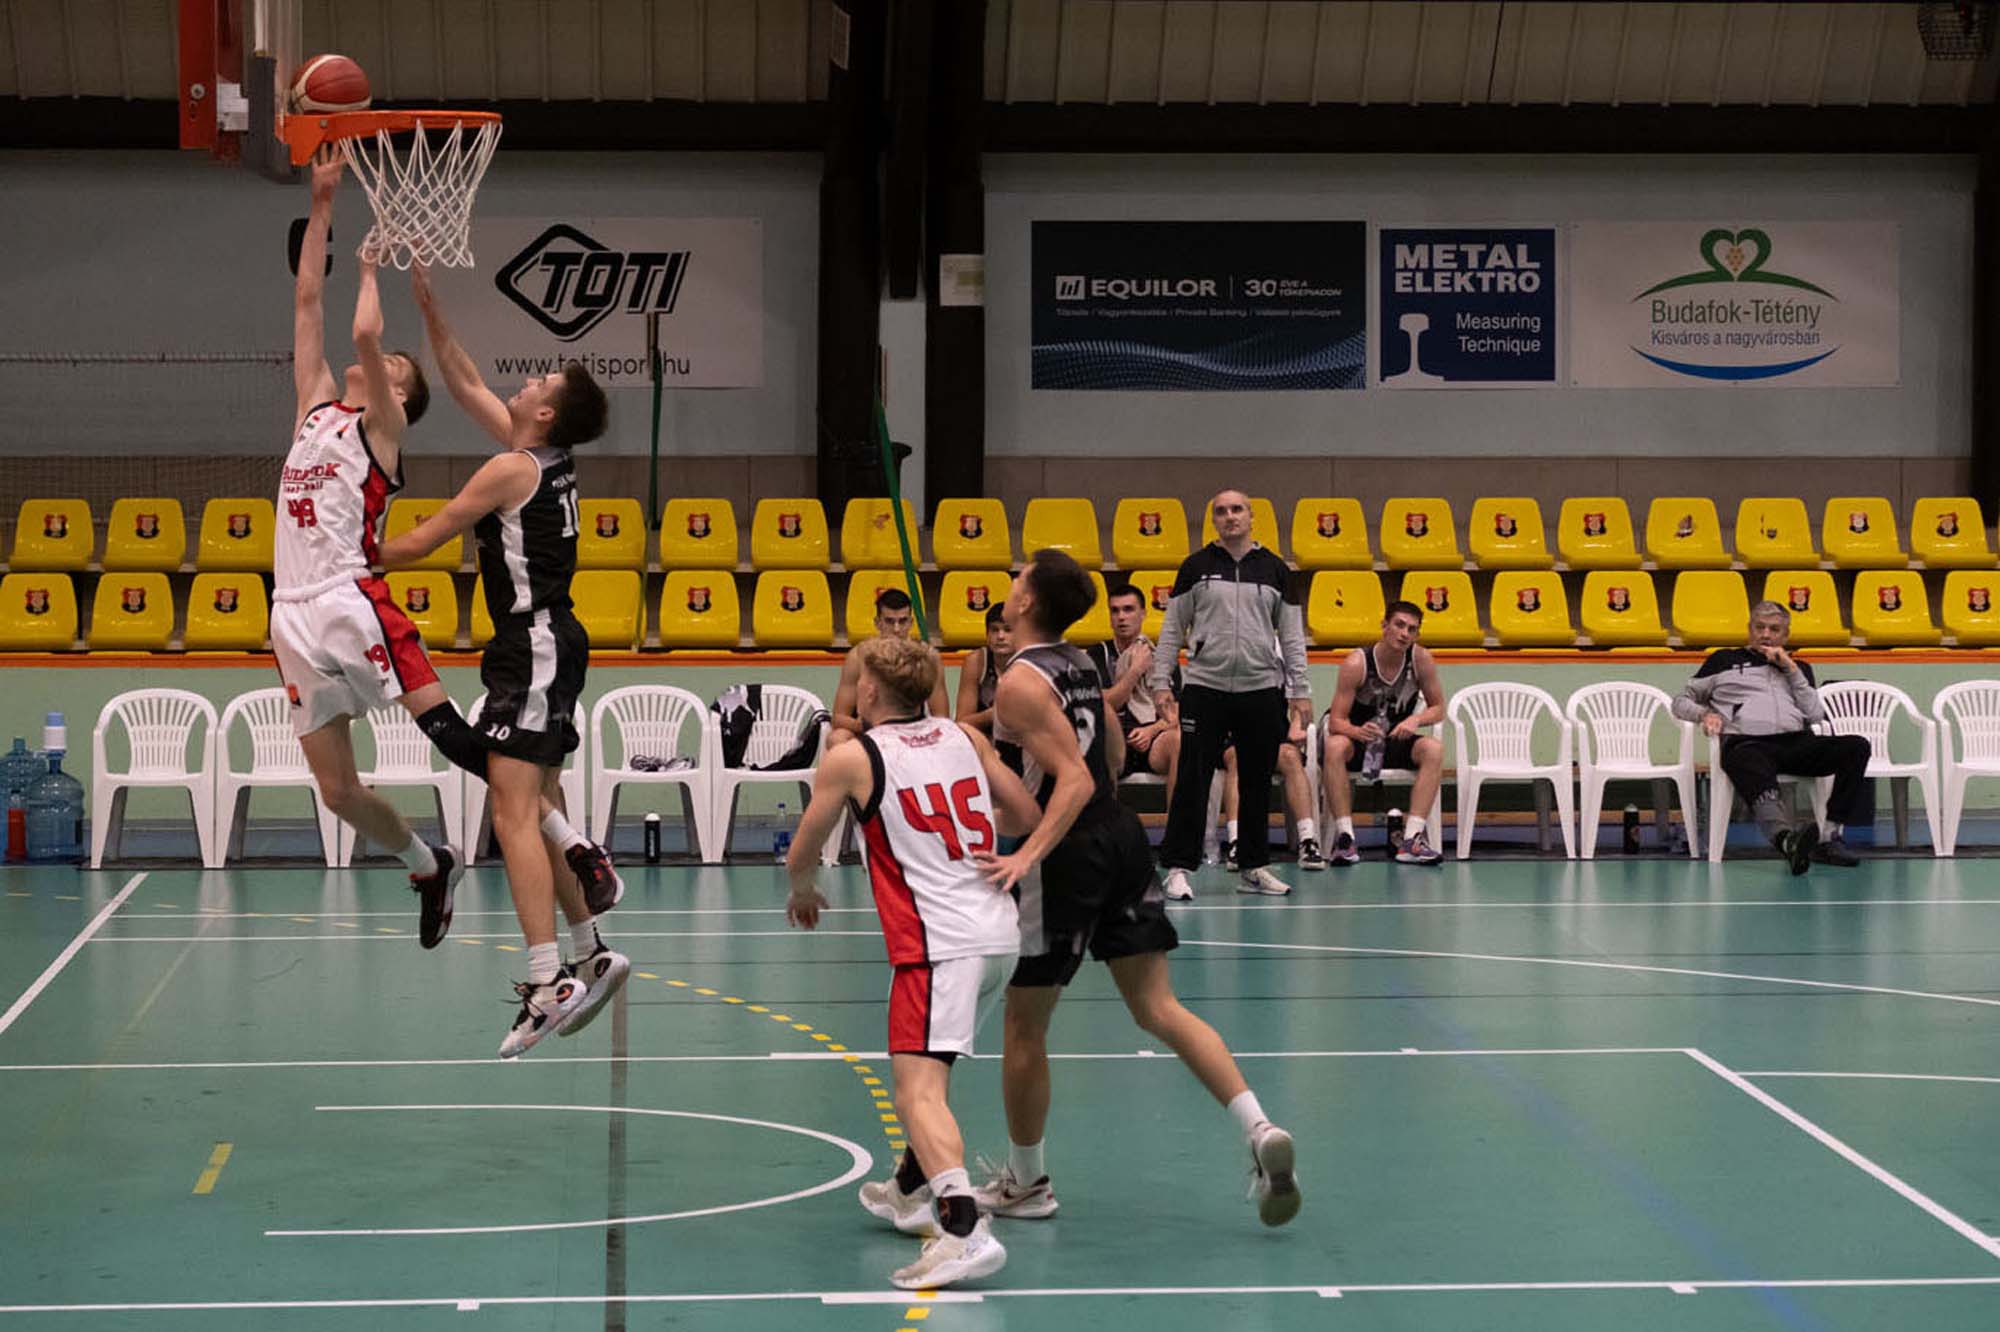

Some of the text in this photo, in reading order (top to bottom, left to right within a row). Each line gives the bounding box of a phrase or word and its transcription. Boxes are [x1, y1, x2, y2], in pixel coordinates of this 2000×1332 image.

[1395, 244, 1541, 269] METAL
[540, 251, 690, 313] TOTI
[1092, 279, 1277, 299] EQUILOR 30
[1395, 271, 1541, 293] ELEKTRO
[1456, 312, 1541, 333] Measuring
[1652, 299, 1821, 329] Budafok-Tétény
[1458, 336, 1541, 356] Technique
[1652, 329, 1820, 348] Kisváros a nagyvárosban
[495, 352, 690, 380] www.totisporhu
[897, 776, 994, 861] 45
